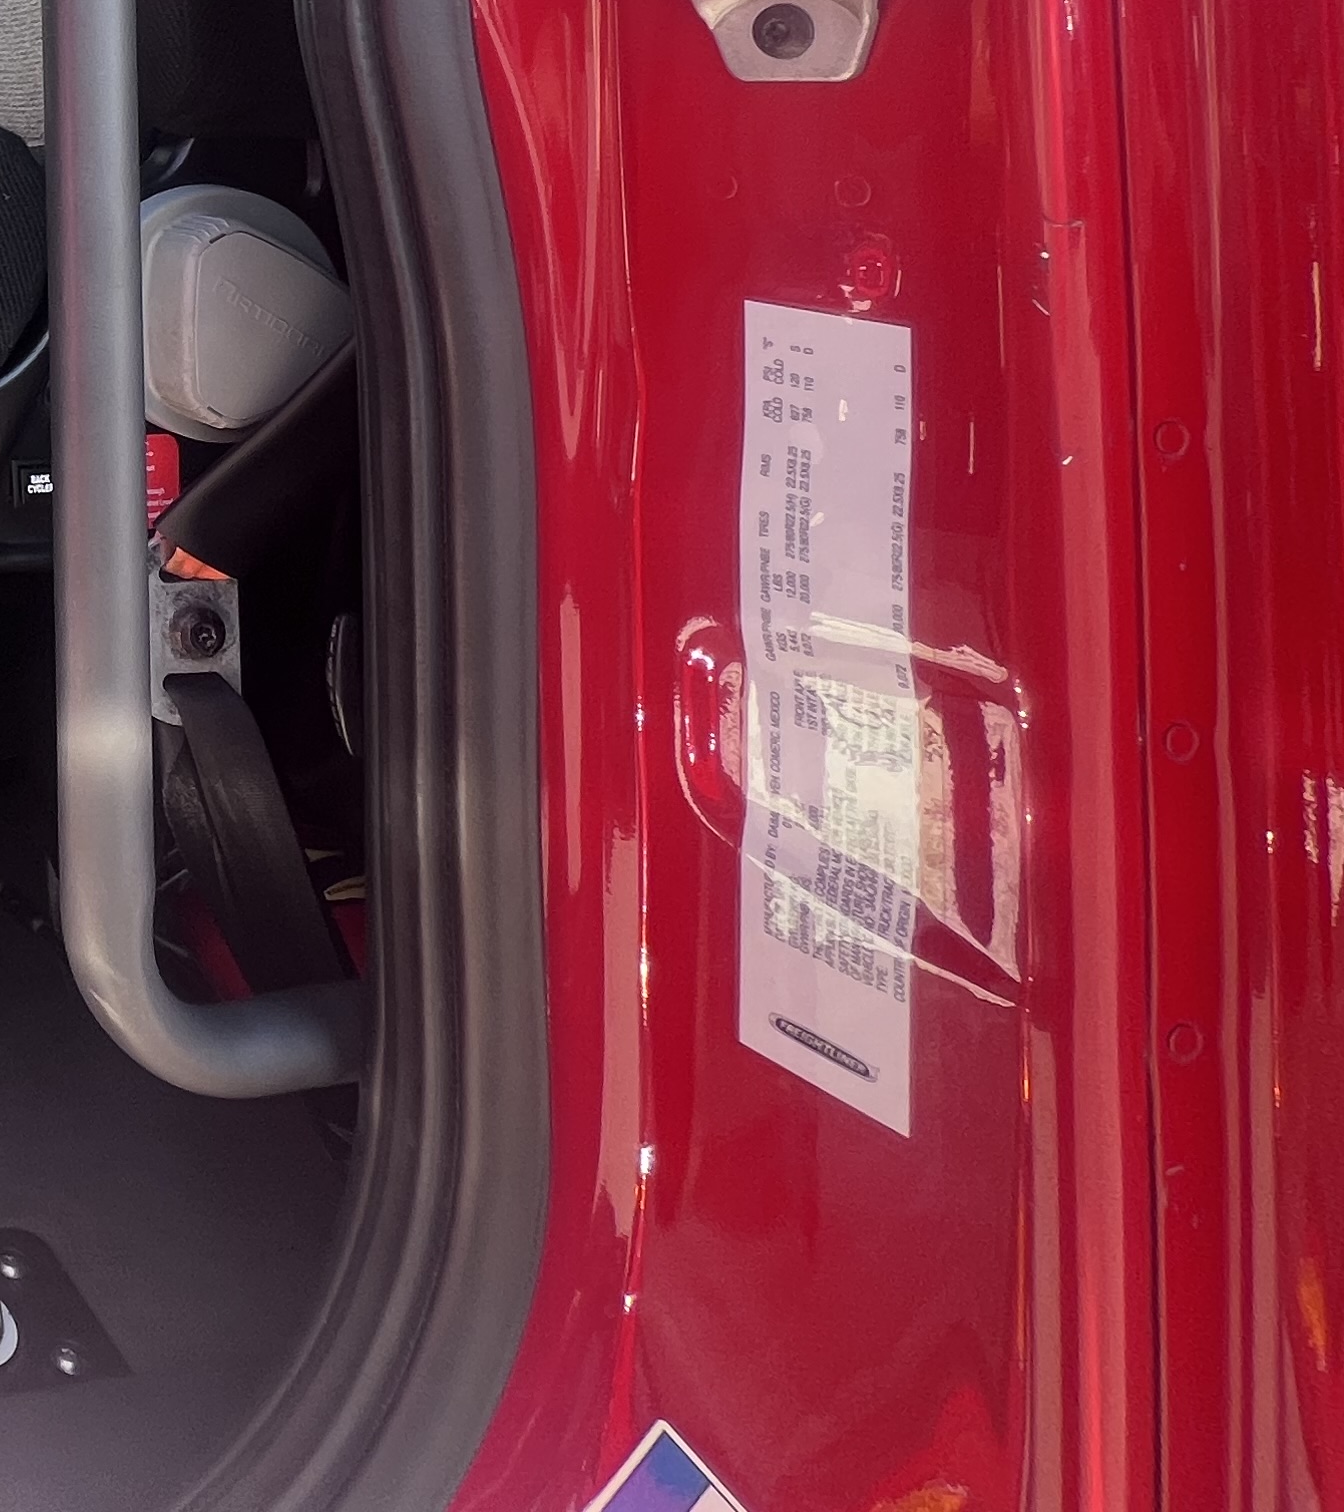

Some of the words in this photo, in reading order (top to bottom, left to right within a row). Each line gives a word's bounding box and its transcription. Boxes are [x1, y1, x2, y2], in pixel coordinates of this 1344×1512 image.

[803, 347, 814, 355] D
[774, 358, 784, 385] COLD
[894, 364, 906, 373] D
[790, 373, 800, 388] 120
[803, 376, 814, 391] 110
[773, 397, 783, 423] COLD
[894, 395, 905, 410] 110
[773, 573, 783, 592] LBS
[770, 690, 780, 728] MEXICO
[897, 900, 911, 938] ORIGIN
